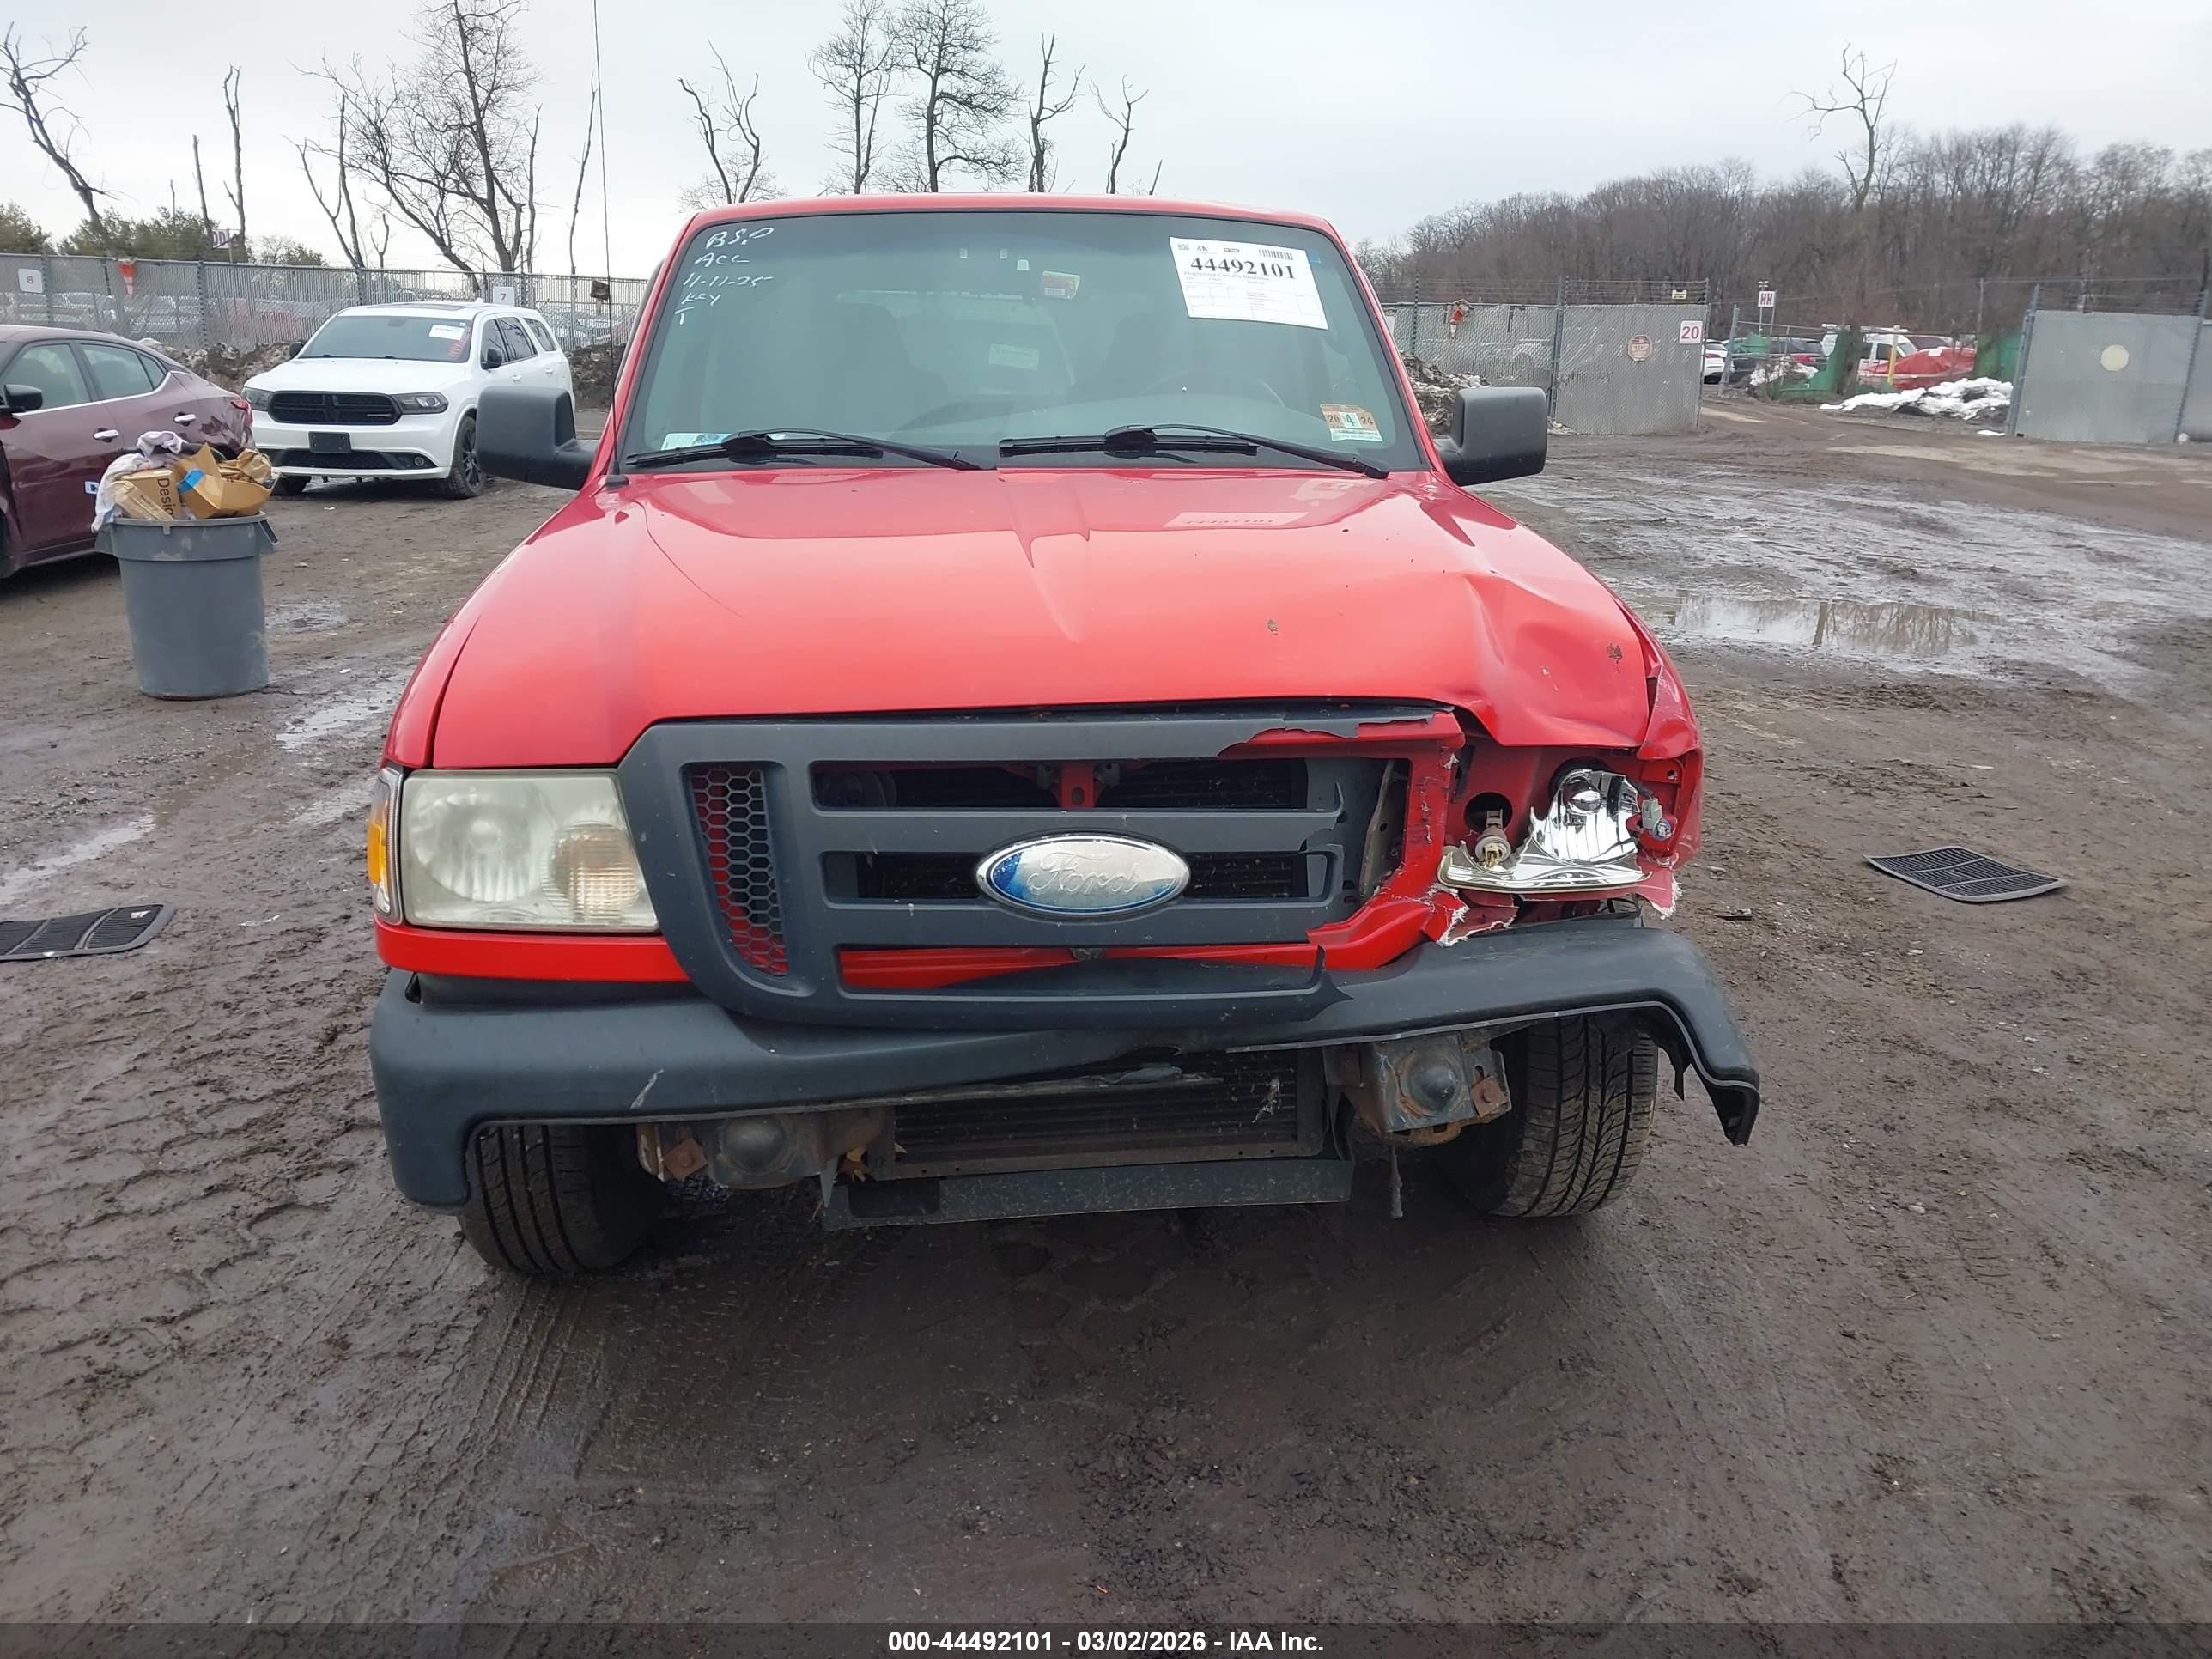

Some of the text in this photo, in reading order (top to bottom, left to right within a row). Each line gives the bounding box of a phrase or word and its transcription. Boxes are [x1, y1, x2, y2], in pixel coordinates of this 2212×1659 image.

[1190, 257, 1296, 279] 44492101
[1681, 326, 1699, 339] 20
[1027, 851, 1140, 895] Ford
